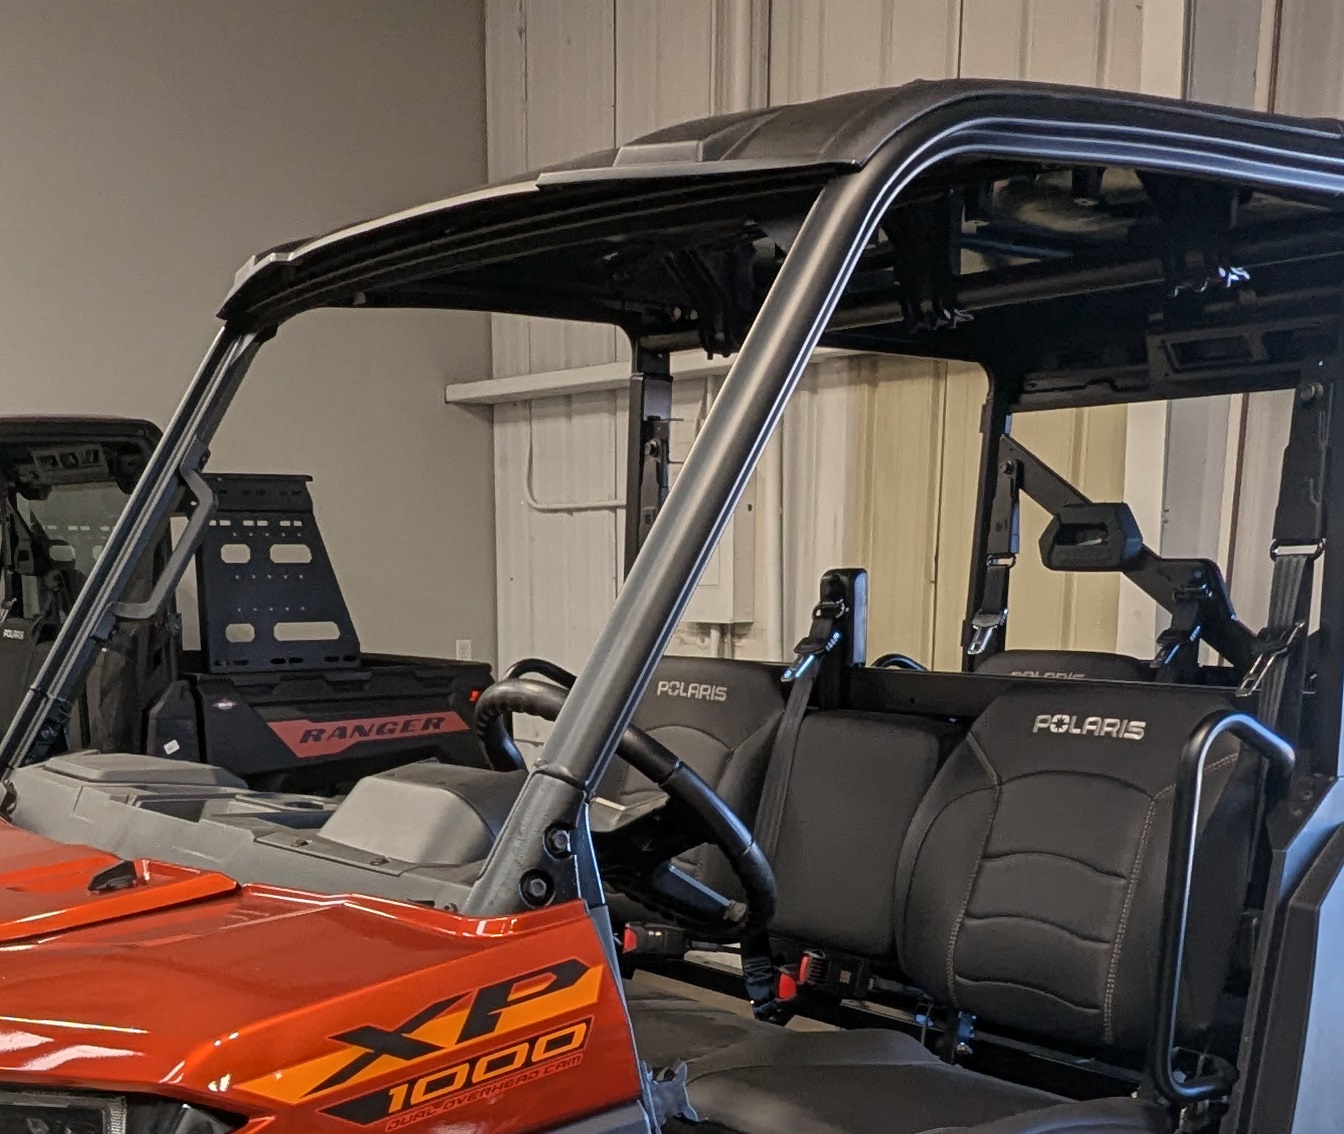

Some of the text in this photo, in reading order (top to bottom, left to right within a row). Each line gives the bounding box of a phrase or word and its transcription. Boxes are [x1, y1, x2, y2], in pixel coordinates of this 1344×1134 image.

[657, 681, 728, 702] POLARIS
[299, 717, 446, 744] RANGER
[1032, 714, 1147, 740] POLARIS
[301, 958, 591, 1098] XP
[387, 1054, 583, 1131] DUAL OVERHEAD CAM
[388, 1022, 587, 1113] 1000
